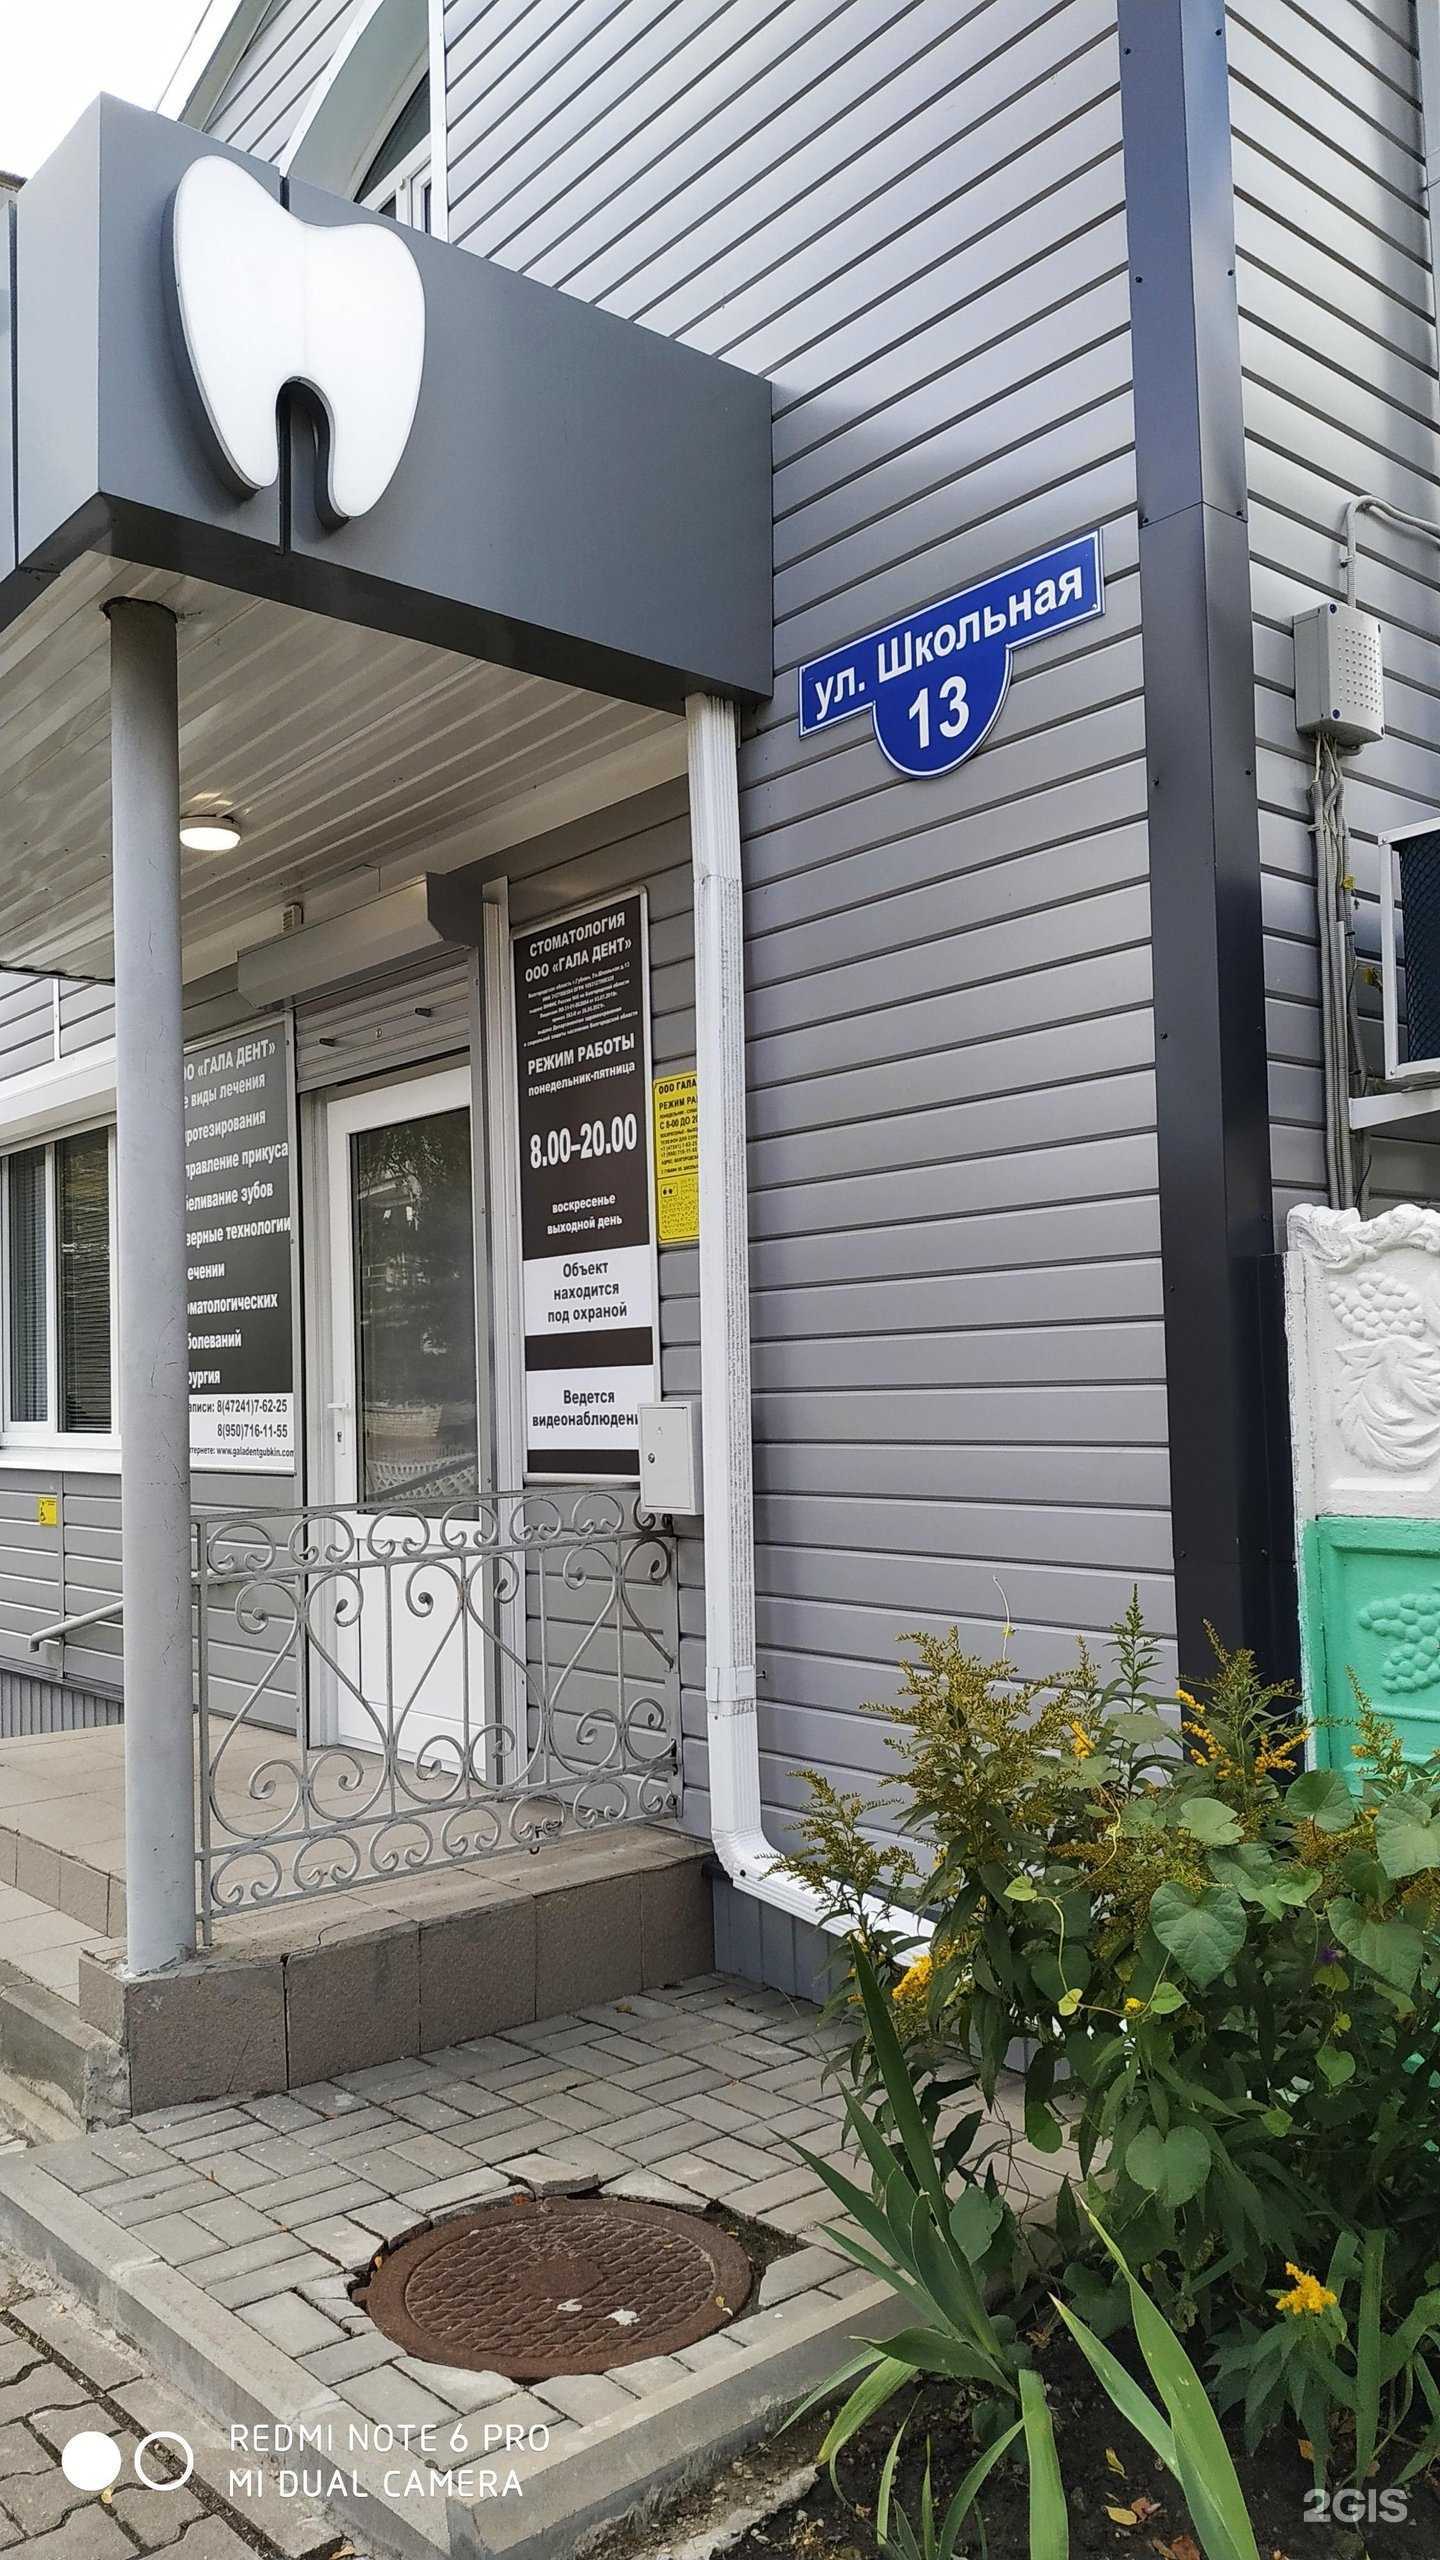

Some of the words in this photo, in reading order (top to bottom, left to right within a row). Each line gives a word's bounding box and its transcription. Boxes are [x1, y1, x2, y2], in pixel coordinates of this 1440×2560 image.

[815, 666, 865, 721] ул.
[877, 566, 1083, 684] Школьная
[908, 675, 970, 749] 13
[529, 911, 625, 957] СТОМАТОЛОГИЯ
[525, 963, 549, 983] ООО
[552, 949, 589, 973] «ГАЛА
[591, 937, 632, 963] ДЕНТ»
[198, 1050, 234, 1076] «ГАЛА
[236, 1039, 276, 1068] ДЕНТ»
[527, 1047, 575, 1076] РЕЖИМ
[577, 1032, 635, 1063] РАБОТЫ
[191, 1086, 217, 1108] виды
[220, 1073, 265, 1099] лечения
[528, 1061, 636, 1098] понедельник-пятница
[658, 1084, 675, 1094] ООО
[242, 1141, 289, 1169] прикуса
[240, 1180, 274, 1206] зубов
[552, 1193, 616, 1214] воскресенье
[226, 1216, 291, 1241] технологии
[547, 1218, 596, 1235] выходной
[597, 1214, 623, 1230] день
[187, 1263, 225, 1280] ечении
[562, 1261, 609, 1278] Объект
[553, 1281, 620, 1301] находится
[187, 1292, 278, 1315] матологических
[547, 1309, 570, 1324] под
[572, 1301, 628, 1322] охраной
[216, 1399, 288, 1416] 8(47241)7-62-25
[563, 1389, 616, 1406] Ведется
[217, 1424, 288, 1440] 8(950)716-11-55
